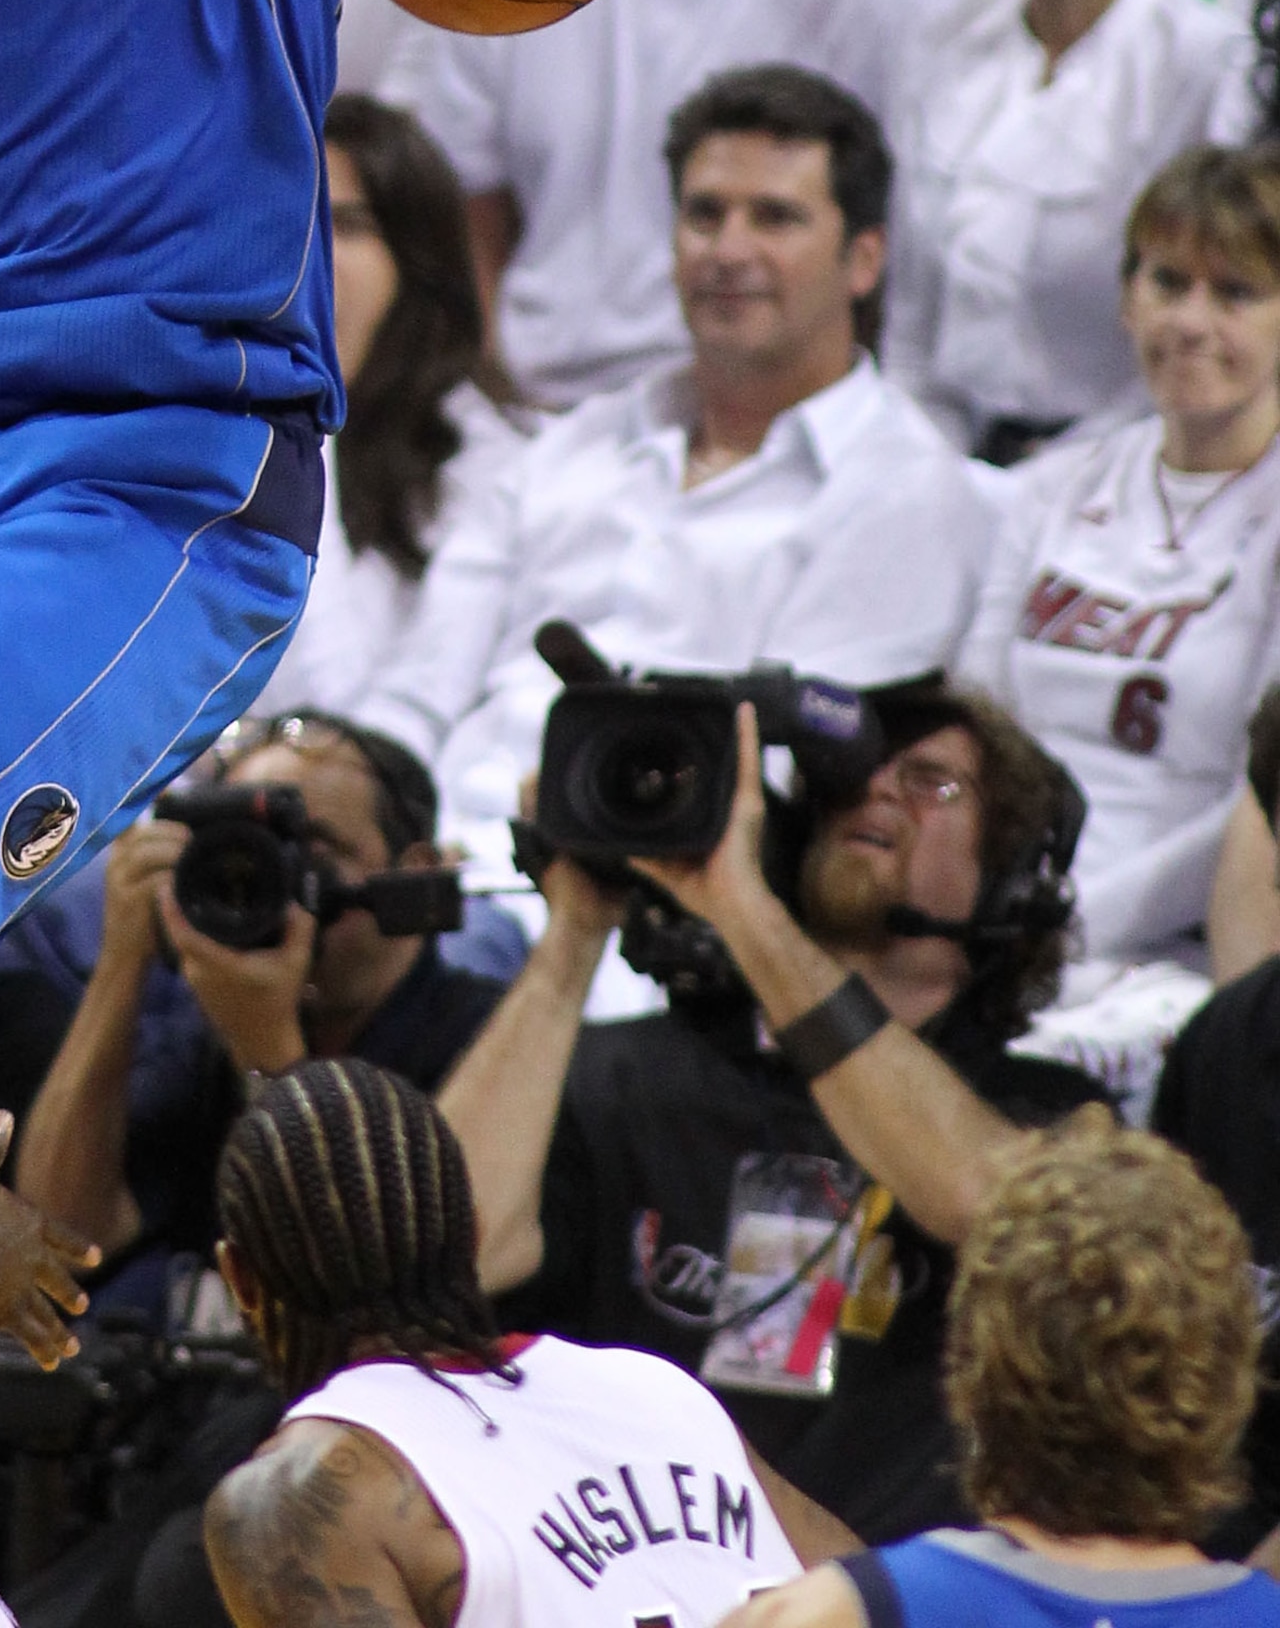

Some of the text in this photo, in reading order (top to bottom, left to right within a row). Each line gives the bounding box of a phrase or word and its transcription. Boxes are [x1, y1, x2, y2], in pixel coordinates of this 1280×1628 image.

[1020, 568, 1232, 661] HEAT
[1111, 674, 1168, 755] 6
[531, 1462, 754, 1590] HASLEM
